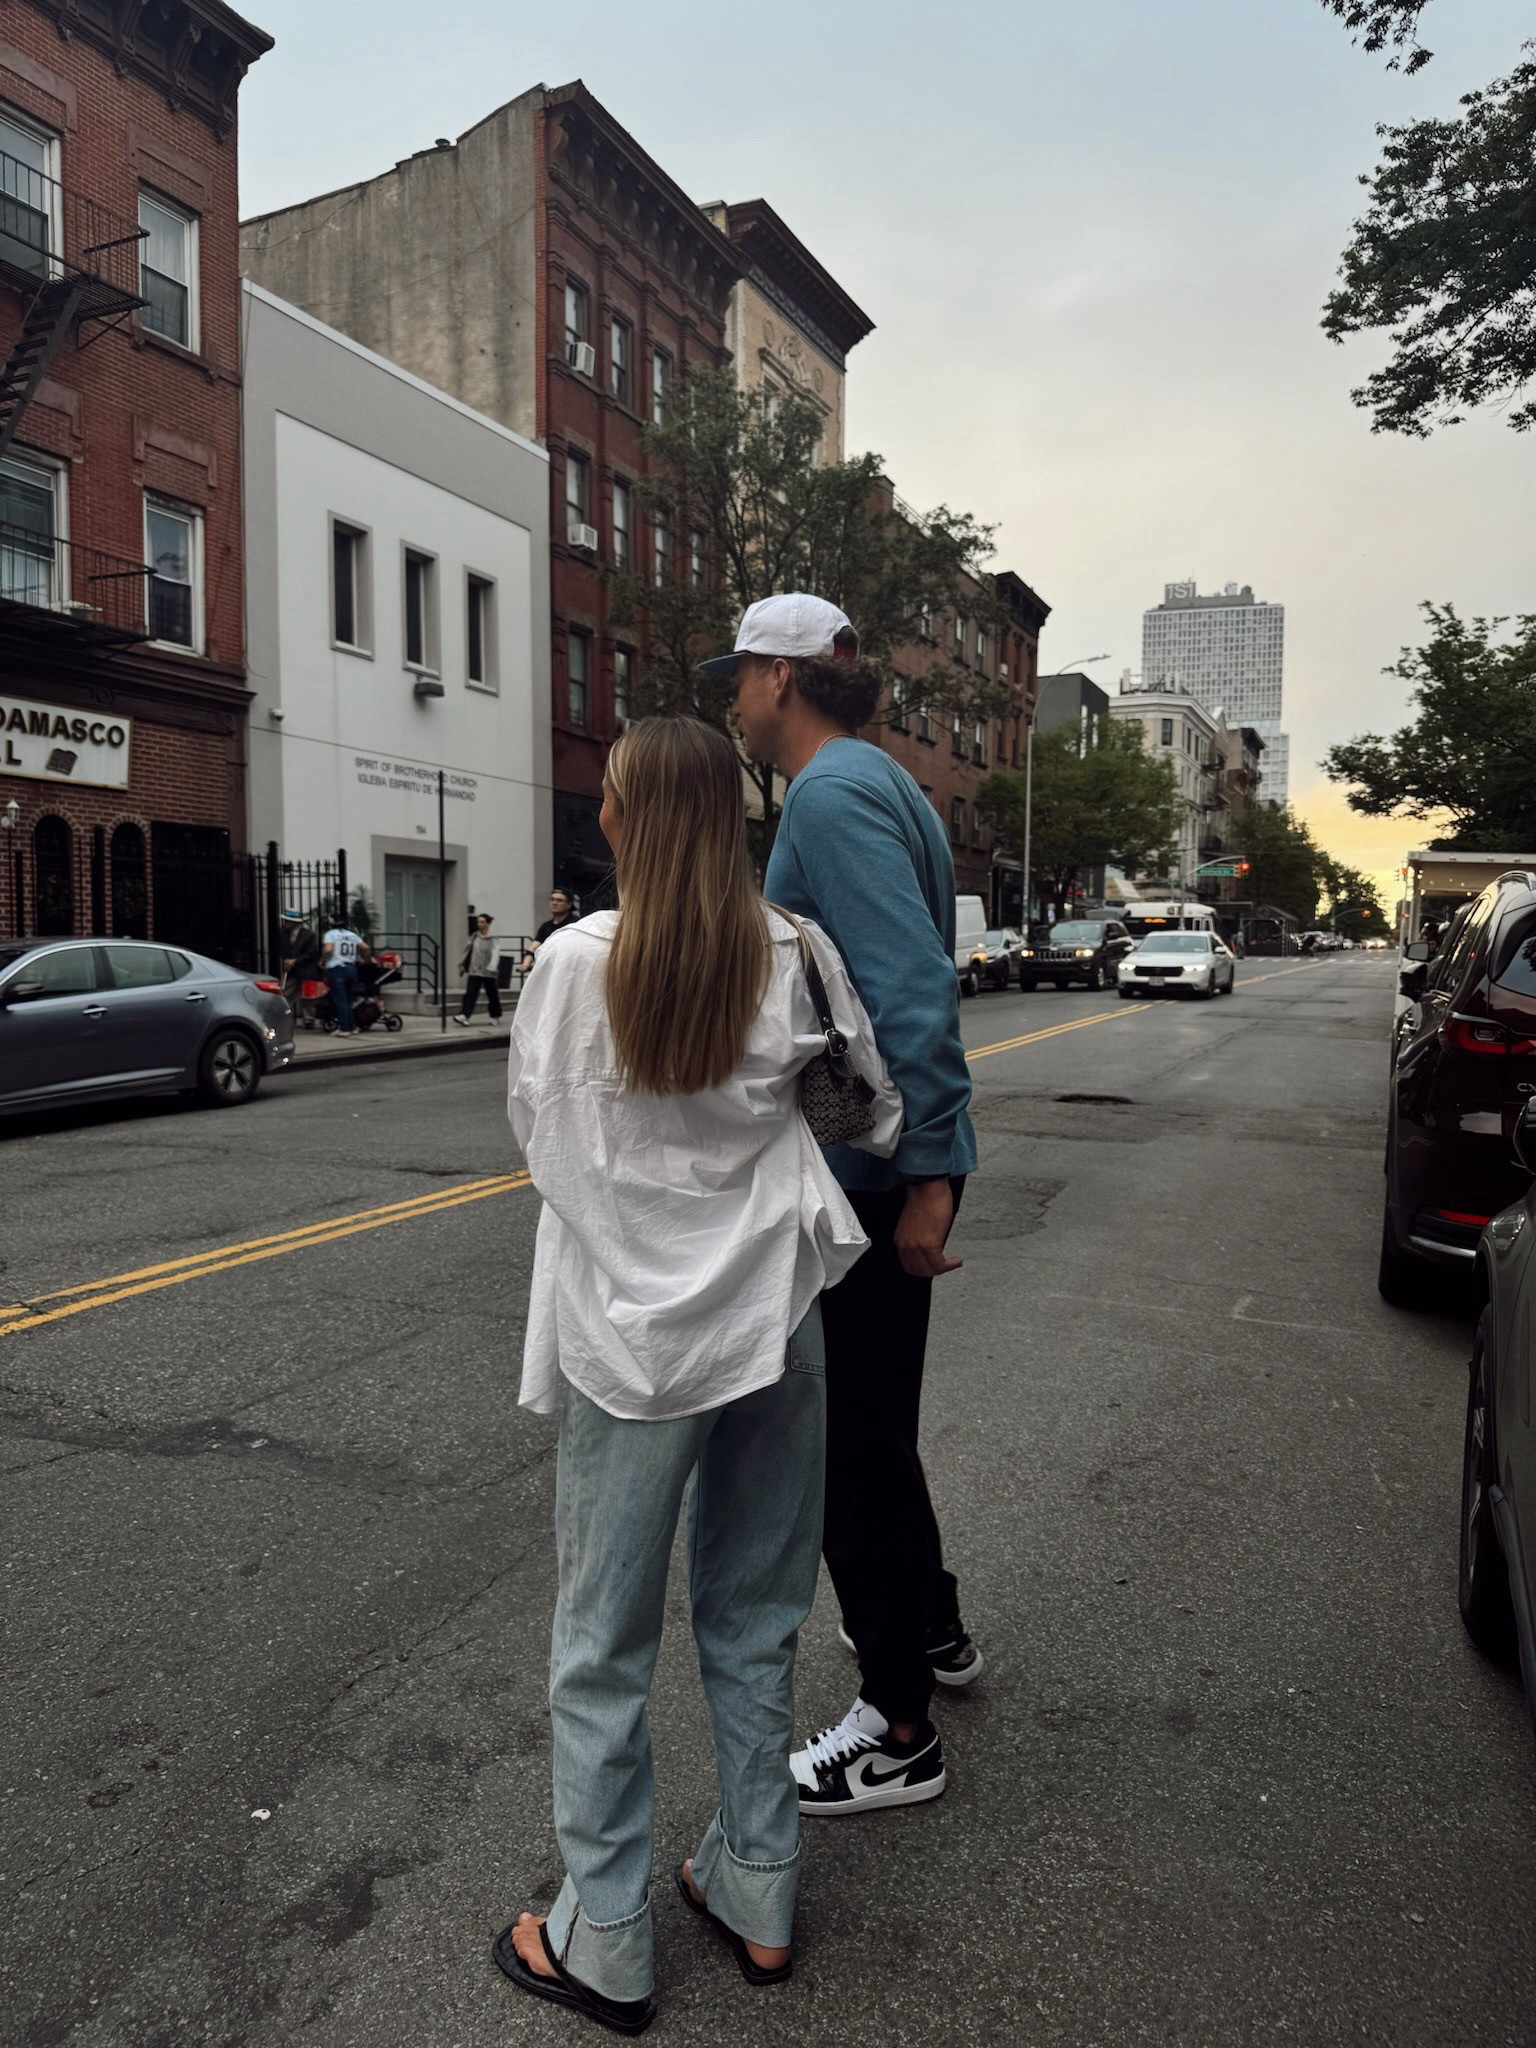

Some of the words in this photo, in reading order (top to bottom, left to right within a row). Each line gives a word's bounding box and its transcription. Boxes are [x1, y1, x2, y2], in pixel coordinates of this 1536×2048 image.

[0, 740, 22, 766] L
[355, 757, 379, 770] SPIRIT
[382, 762, 392, 773] OF
[394, 764, 448, 784] BROTHERHOD
[450, 775, 478, 789] CHURCH
[358, 773, 387, 787] IGLESIA
[389, 779, 421, 793] ESPIRITU
[423, 784, 433, 795] DE
[435, 787, 476, 802] HRMANDAD
